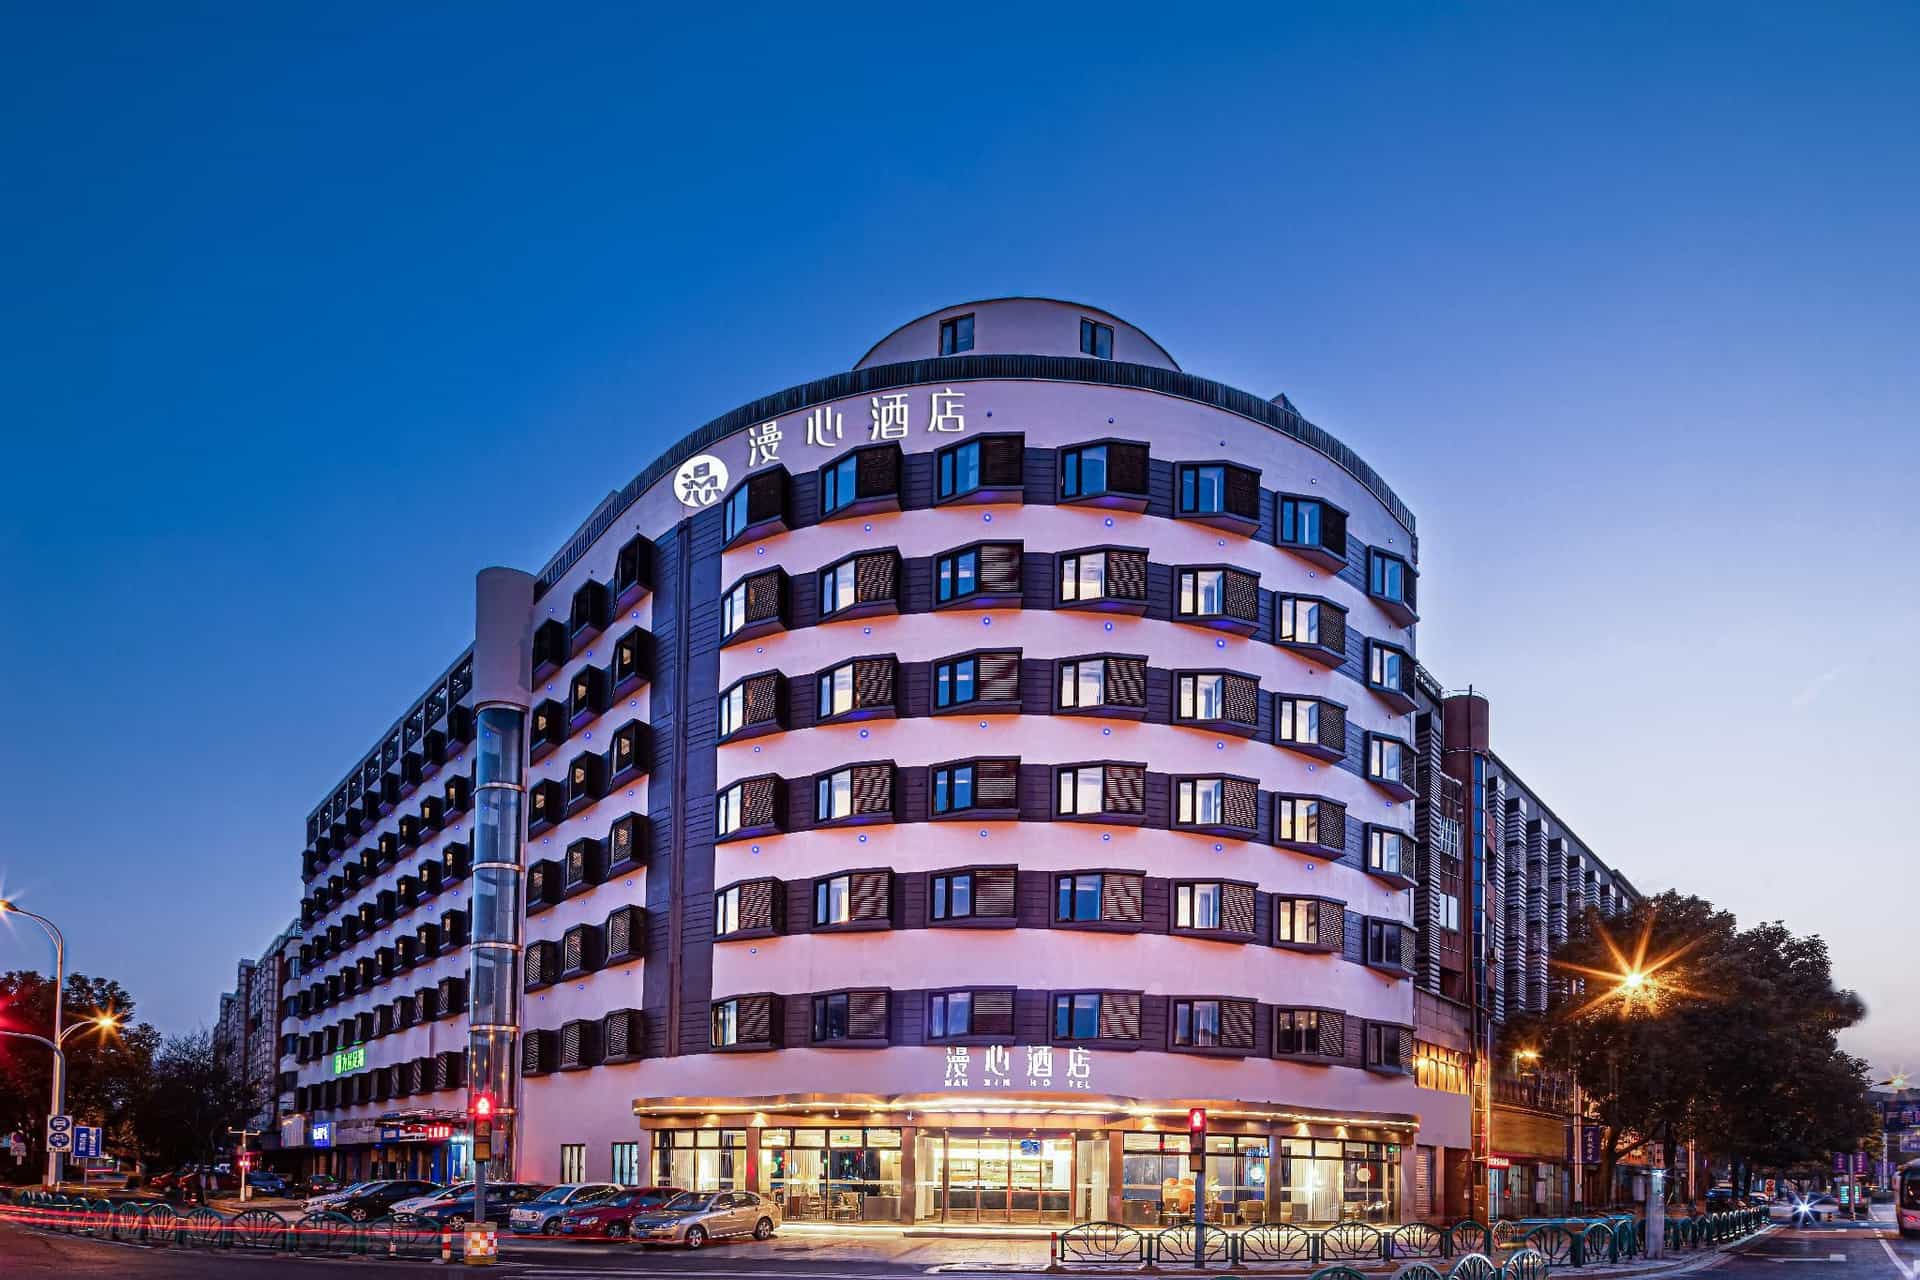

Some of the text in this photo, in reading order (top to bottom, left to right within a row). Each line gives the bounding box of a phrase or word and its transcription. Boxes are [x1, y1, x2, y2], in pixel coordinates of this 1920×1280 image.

[749, 388, 966, 467] 漫心酒店
[945, 1045, 1091, 1078] 漫心酒店
